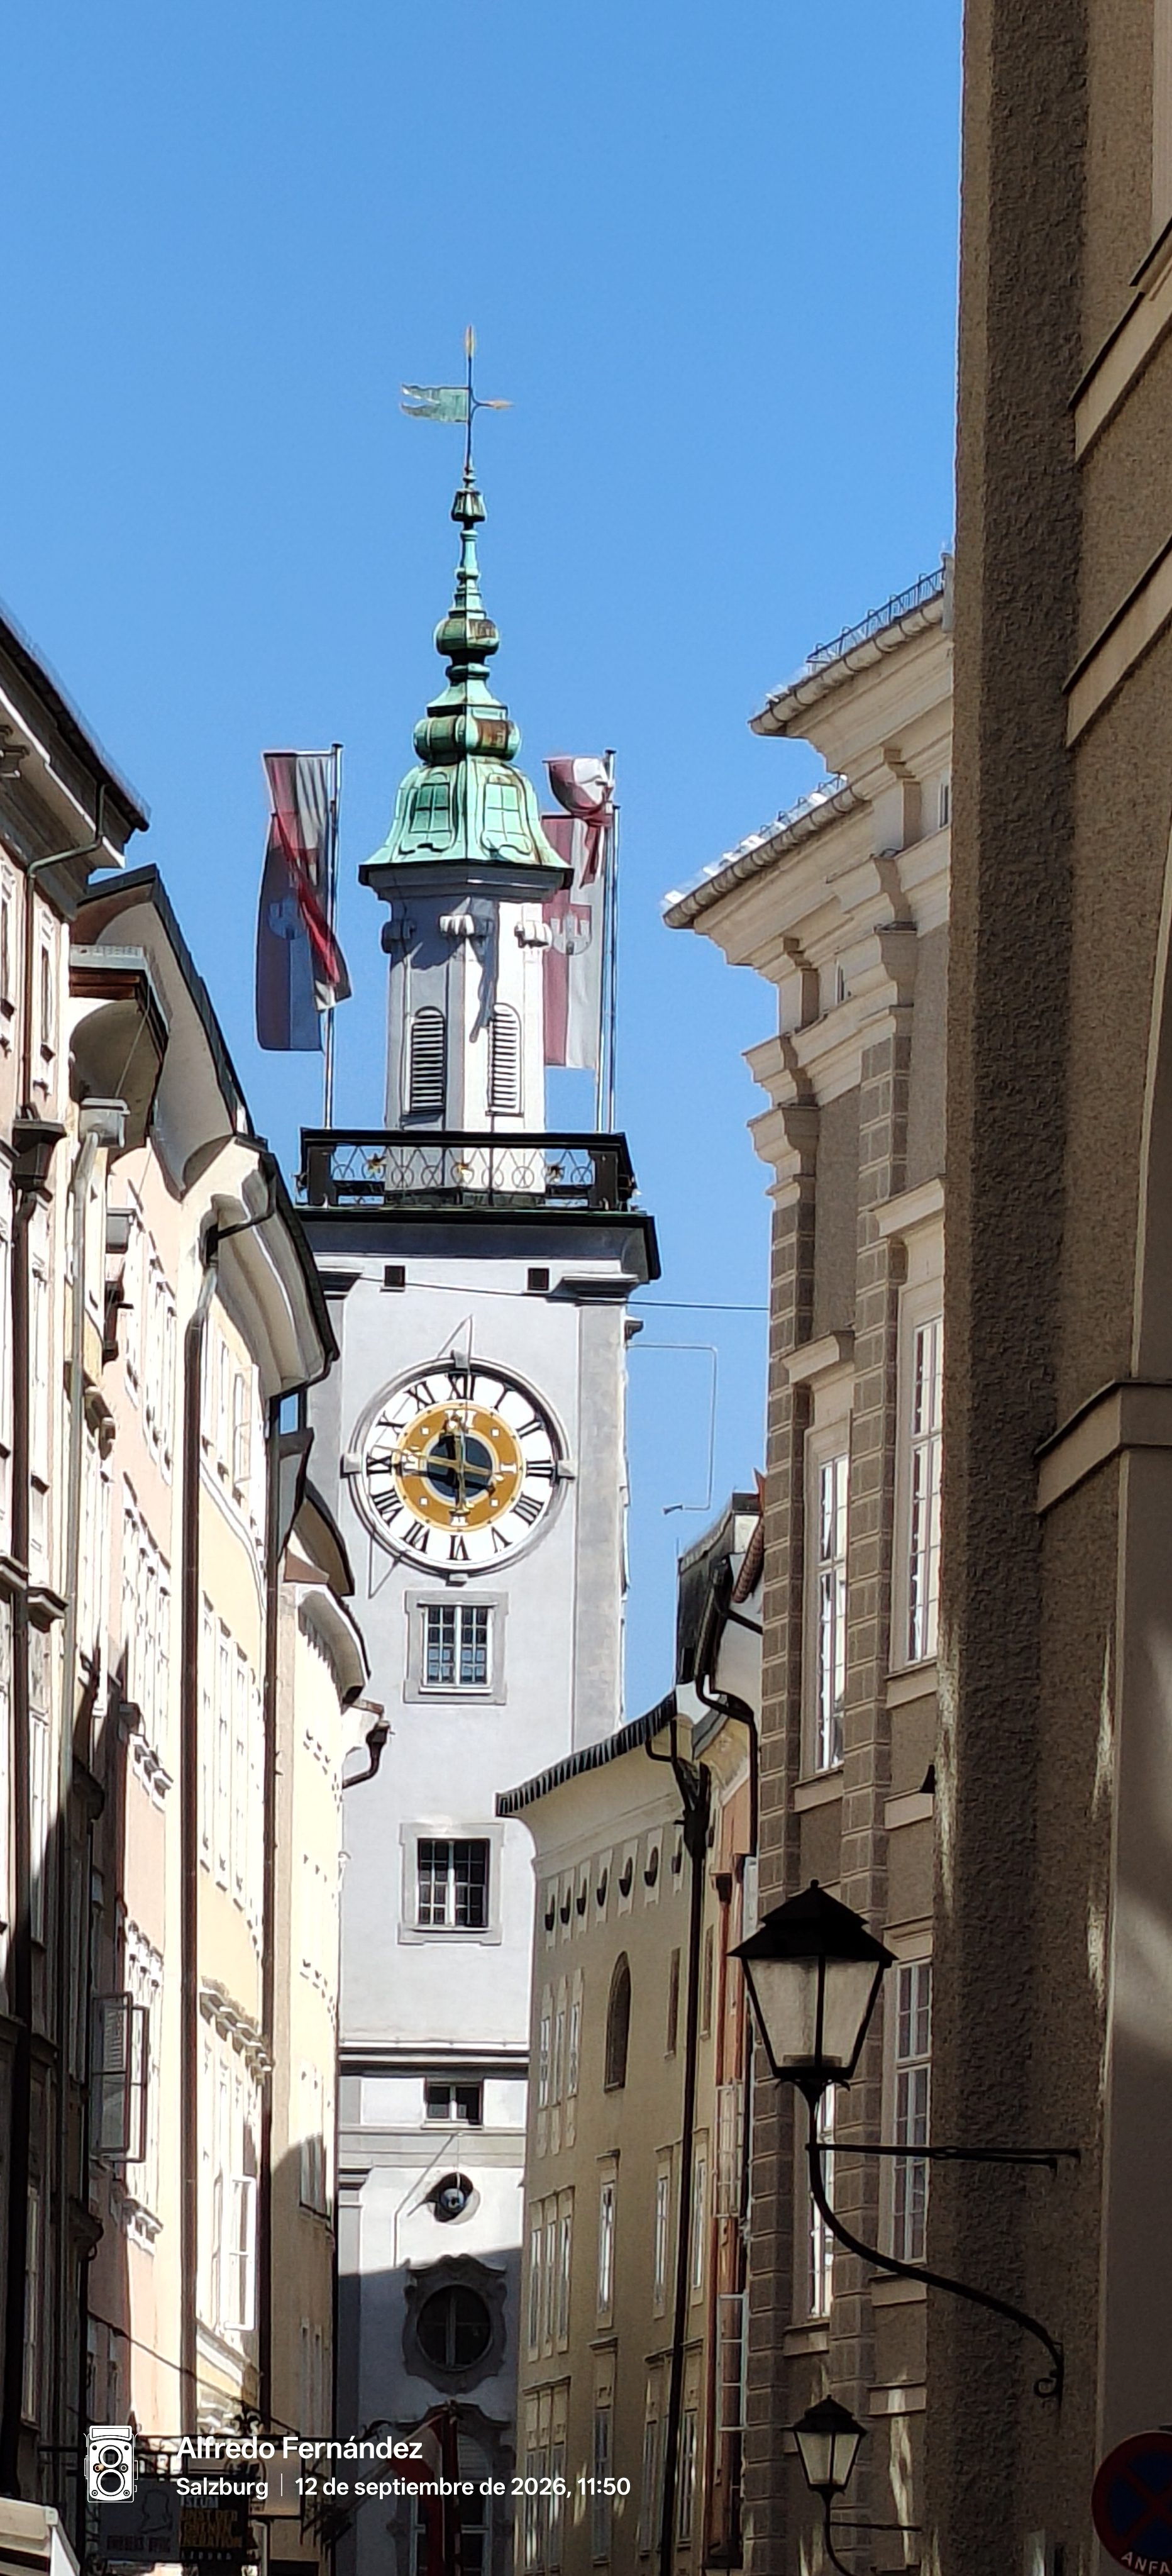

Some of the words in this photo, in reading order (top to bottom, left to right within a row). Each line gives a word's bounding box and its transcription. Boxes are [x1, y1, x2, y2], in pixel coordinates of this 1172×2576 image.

[404, 1380, 437, 1413] XI
[446, 1373, 476, 1401] XII
[376, 1411, 406, 1437] X
[516, 1417, 546, 1440] II
[526, 1457, 553, 1479] III
[370, 1487, 404, 1526] VIII
[399, 1519, 431, 1555] VII
[447, 1535, 471, 1561] VI
[491, 1527, 514, 1554] V
